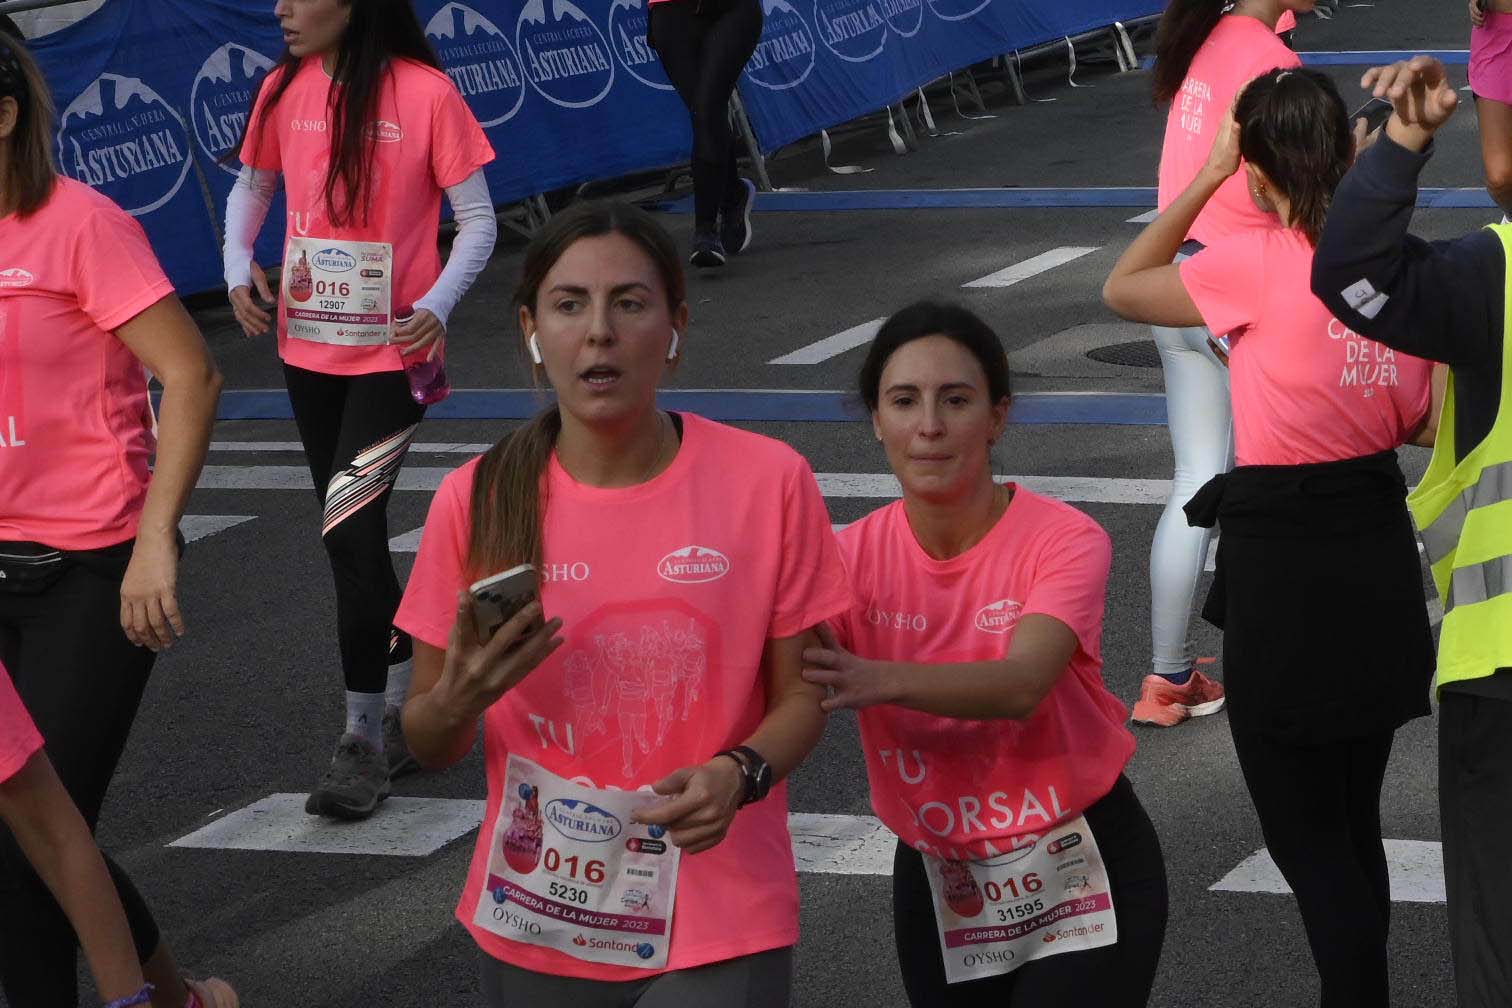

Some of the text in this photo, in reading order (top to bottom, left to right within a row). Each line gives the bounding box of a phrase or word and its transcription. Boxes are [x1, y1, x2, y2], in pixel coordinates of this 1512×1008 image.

[524, 38, 610, 83] ASTURIANA
[315, 256, 354, 269] ASTURIANA
[315, 280, 350, 297] 016
[294, 311, 320, 320] CARRERA
[320, 313, 330, 321] DE
[339, 314, 361, 322] MUJER
[319, 299, 346, 311] 12907
[294, 324, 381, 338] OYSHO Santander
[1346, 341, 1369, 363] DE
[1339, 364, 1398, 388] MUJER
[663, 560, 725, 576] ASTURIANA
[528, 713, 576, 756] TU
[549, 805, 616, 837] ASTURIANA
[543, 847, 606, 884] 016
[548, 881, 589, 905] 5230
[983, 871, 1043, 903] 016
[502, 884, 649, 931] CARRERA DE LA MUJER 2023
[964, 899, 1097, 942] CARRERA DE LA MUJER 2023
[997, 897, 1045, 923] 31595
[492, 907, 639, 954] OYSHO Santand
[963, 922, 1105, 968] OYSHO Santander
